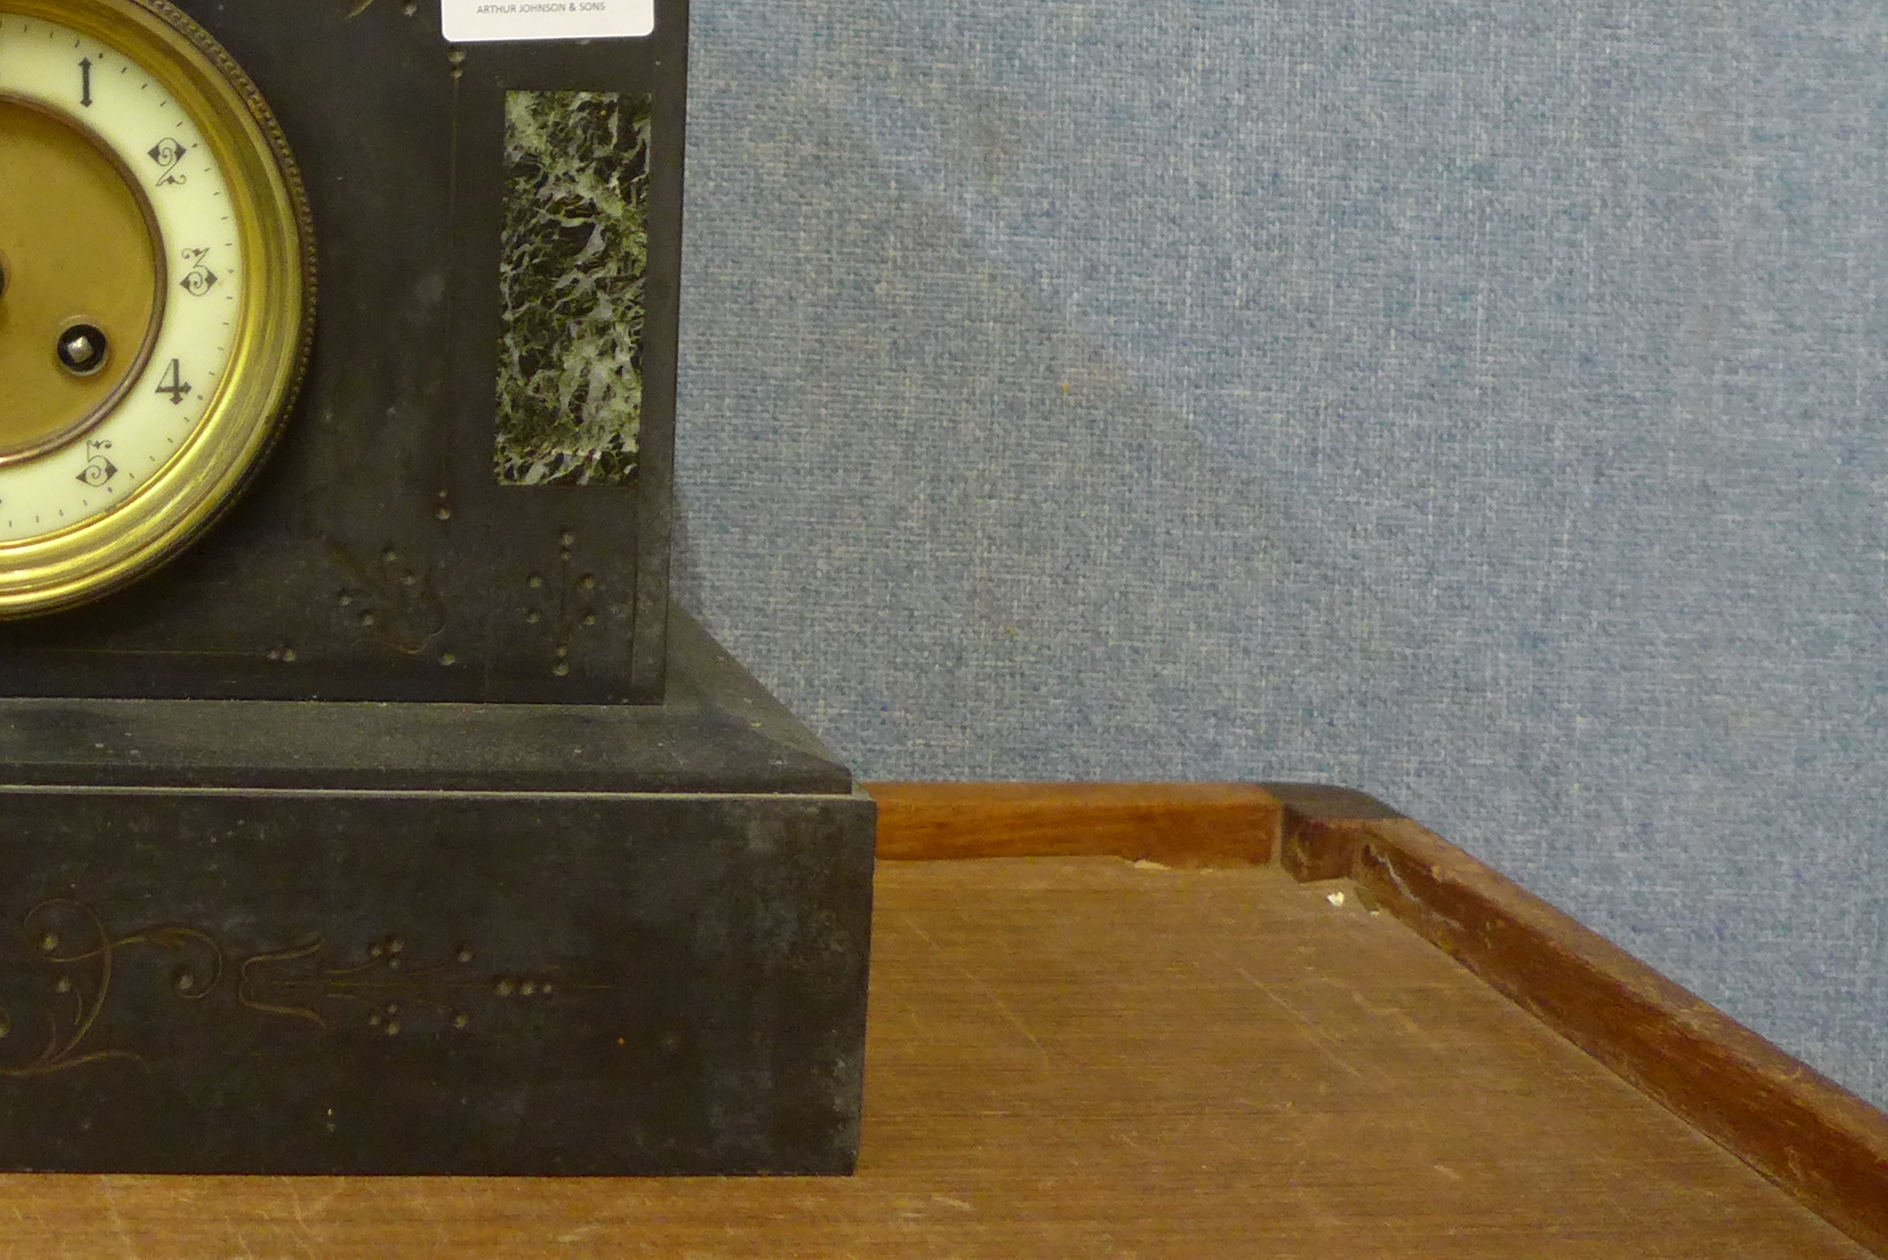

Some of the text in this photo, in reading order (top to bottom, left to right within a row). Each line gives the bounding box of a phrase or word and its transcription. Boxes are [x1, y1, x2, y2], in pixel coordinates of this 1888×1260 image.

[476, 1, 606, 14] ARTHUR JOHNSON & SONS
[78, 57, 93, 107] 1
[147, 137, 187, 187] 2
[178, 247, 218, 296] 3
[155, 357, 192, 405] 4
[76, 439, 118, 487] 5
